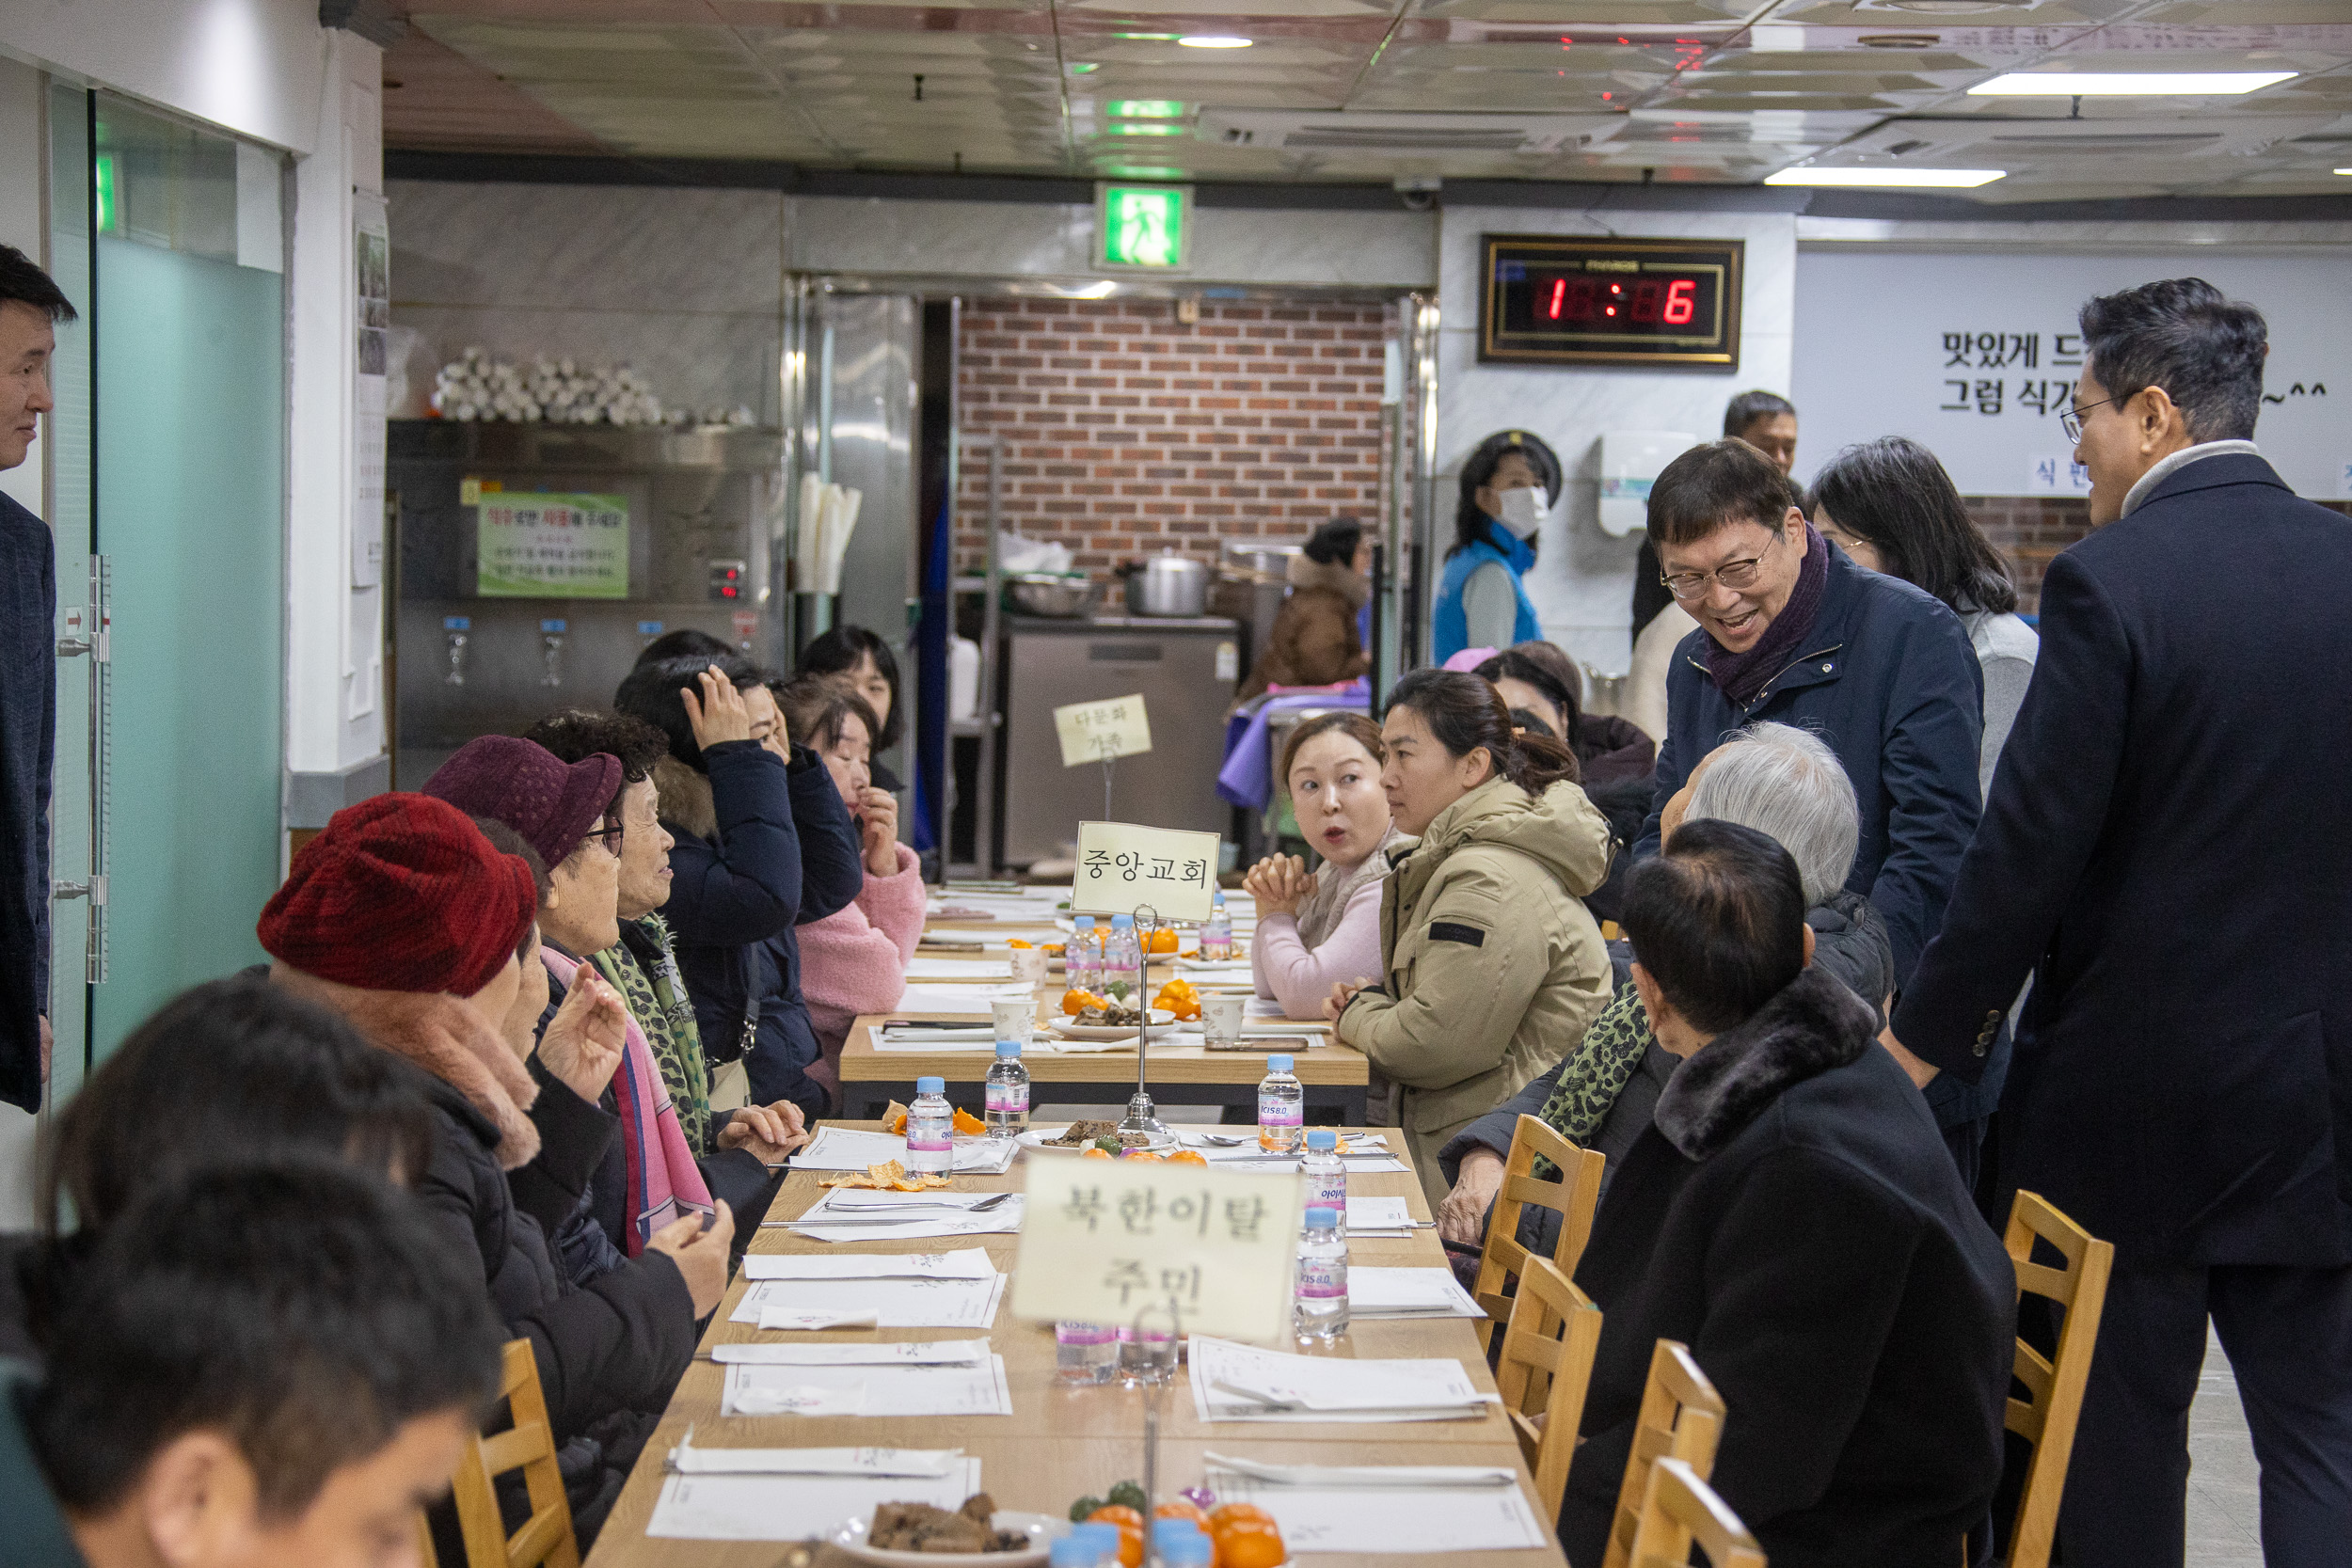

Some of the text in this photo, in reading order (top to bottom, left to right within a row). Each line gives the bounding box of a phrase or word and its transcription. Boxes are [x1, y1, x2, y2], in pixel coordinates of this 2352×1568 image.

[1943, 332, 2089, 369] 맛있게 드
[1940, 379, 2003, 416] 그럼
[1074, 704, 1128, 728] 다문화
[1083, 849, 1207, 890] 중앙교회
[1061, 1183, 1270, 1243] 북한이탈
[1103, 1258, 1201, 1316] 주민
